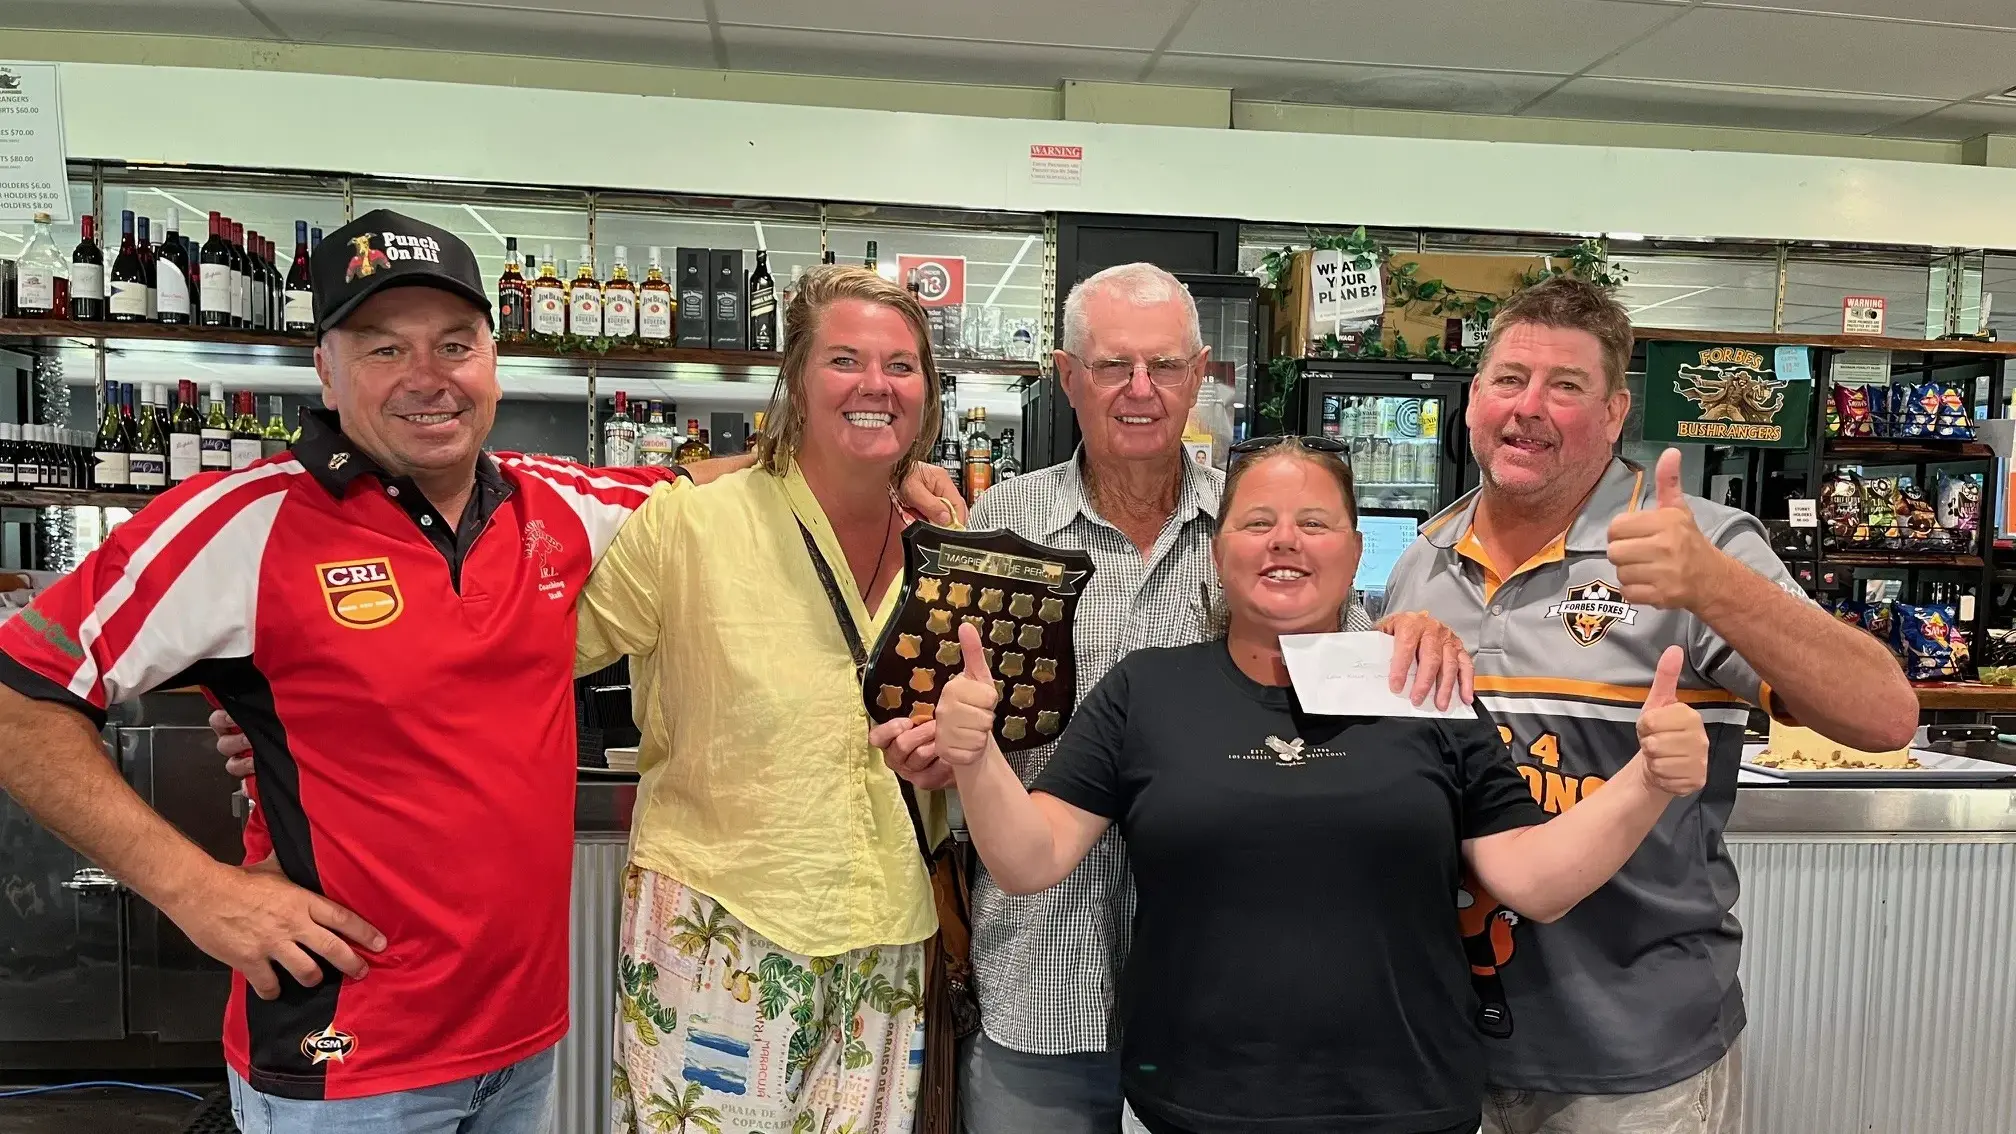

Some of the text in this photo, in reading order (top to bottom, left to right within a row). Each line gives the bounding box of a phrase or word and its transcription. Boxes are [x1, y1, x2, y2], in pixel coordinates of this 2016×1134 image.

[11, 129, 35, 137] $70.00
[1031, 145, 1081, 158] WARNING
[10, 155, 34, 163] $80.00
[4, 192, 37, 200] HOLDERS
[382, 232, 440, 251] Punch
[386, 247, 440, 263] On Ali
[921, 276, 941, 293] 18
[1326, 273, 1367, 288] YOUR
[538, 293, 550, 303] JIM
[574, 292, 600, 304] JIM BEAM
[1361, 285, 1377, 298] B?
[606, 294, 632, 305] JIM BEAM
[642, 295, 669, 306] JIM BEAM
[1847, 299, 1883, 308] WARNING
[1698, 347, 1764, 369] FORBES
[1678, 421, 1782, 441] BUSHRANGERS
[327, 565, 387, 585] CRL
[1003, 563, 1021, 574] THE
[1564, 603, 1624, 615] FORBES FOXES
[1530, 733, 1560, 768] 4
[317, 1039, 342, 1049] CSM
[757, 1040, 771, 1099] MARACUJÁ
[877, 1079, 886, 1093] DE
